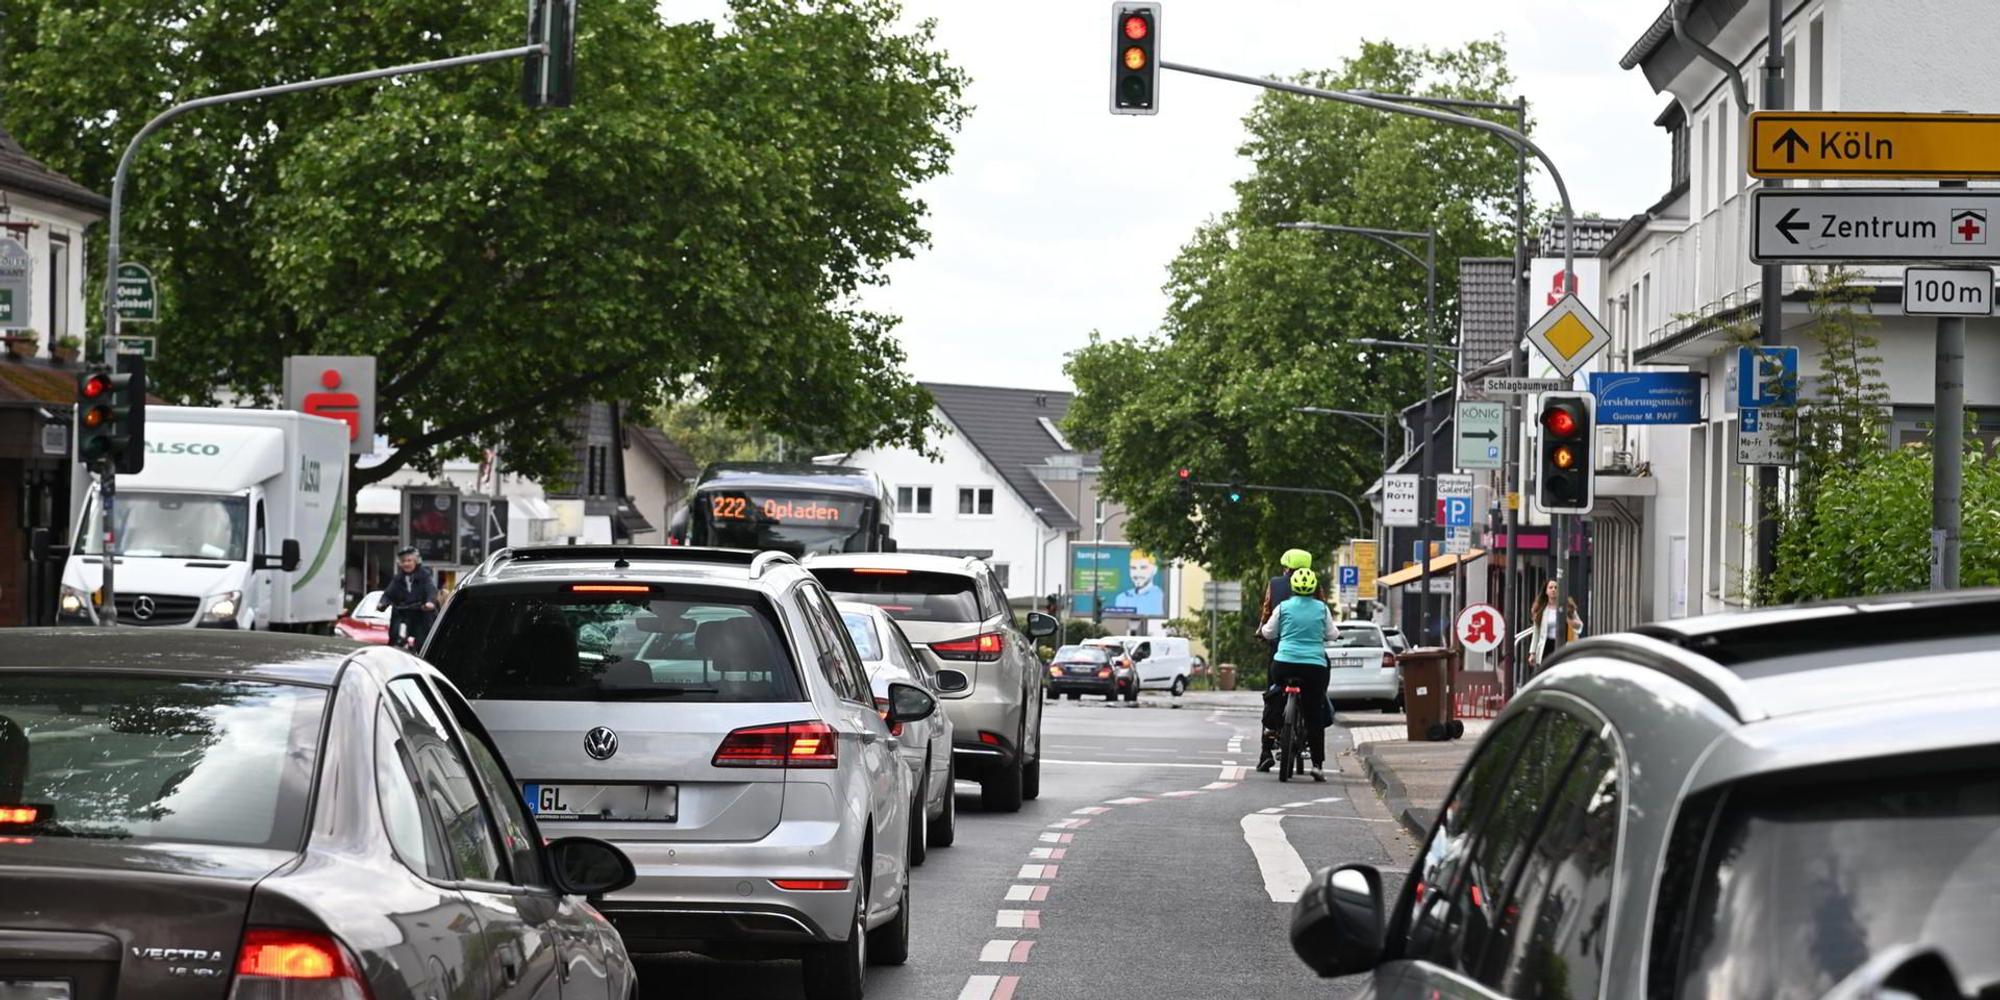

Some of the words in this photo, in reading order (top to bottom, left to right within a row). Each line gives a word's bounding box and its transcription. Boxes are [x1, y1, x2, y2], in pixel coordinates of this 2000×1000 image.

[1820, 130, 1894, 160] Köln
[1821, 214, 1937, 239] Zentrum
[1487, 380, 1559, 392] Schlagbaumweg
[1461, 406, 1500, 419] KÖNIG
[1612, 412, 1642, 421] Gunnar
[1740, 438, 1762, 446] Mo-Fr
[1740, 451, 1749, 459] Sa
[1438, 485, 1473, 494] Galerie
[713, 497, 746, 519] 222
[763, 498, 840, 520] Opladen
[1451, 500, 1467, 524] P
[1343, 568, 1355, 584] P
[540, 788, 567, 811] GL
[132, 947, 222, 961] VECTRA
